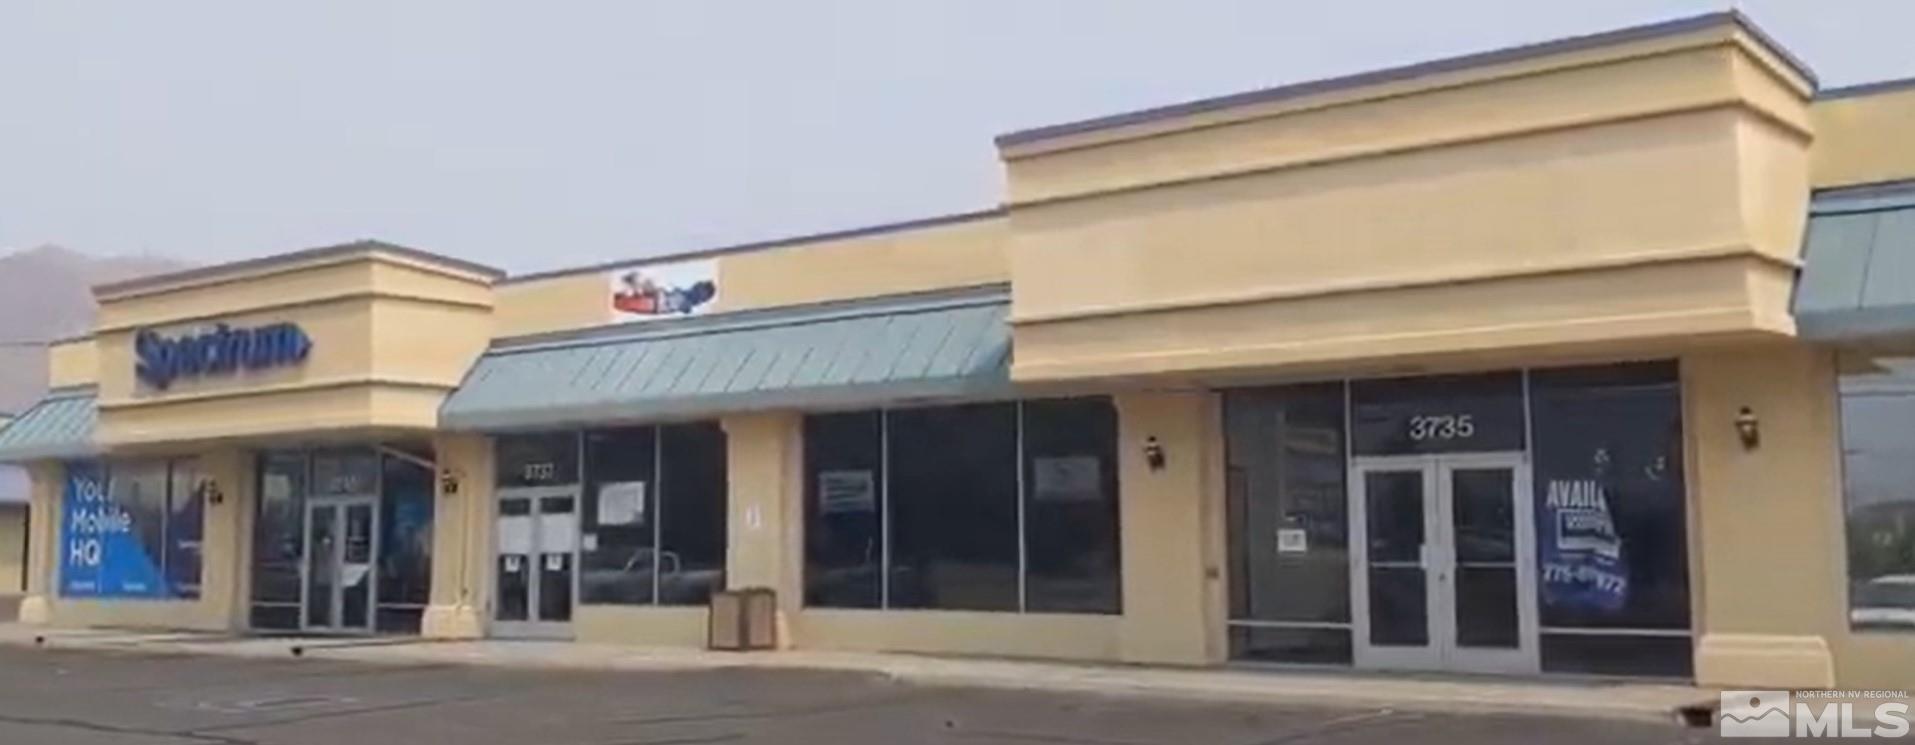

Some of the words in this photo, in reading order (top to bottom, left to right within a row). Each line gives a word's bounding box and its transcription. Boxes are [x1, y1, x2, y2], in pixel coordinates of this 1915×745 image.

[135, 323, 303, 390] Spectrum
[1410, 415, 1474, 439] 3735
[70, 539, 101, 566] HQ
